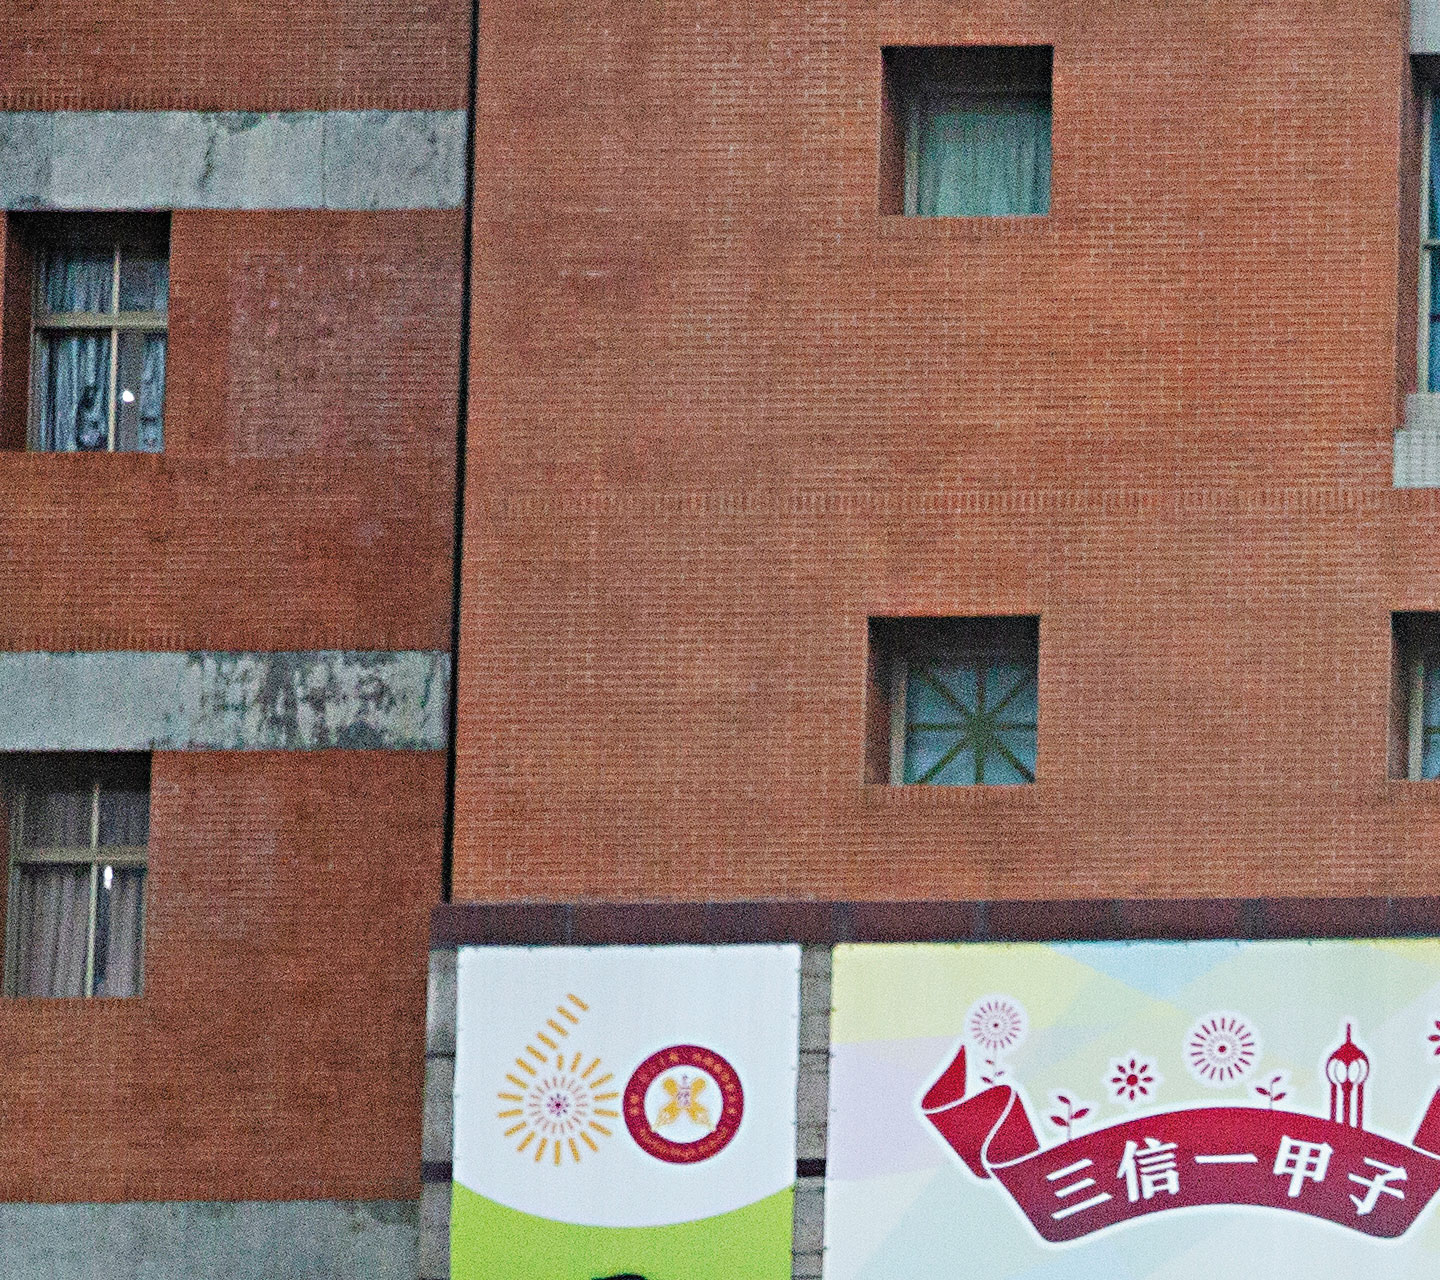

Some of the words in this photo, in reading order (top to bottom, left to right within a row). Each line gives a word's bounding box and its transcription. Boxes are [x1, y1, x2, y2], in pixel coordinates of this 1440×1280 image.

[1044, 1134, 1409, 1221] 三信一甲子
